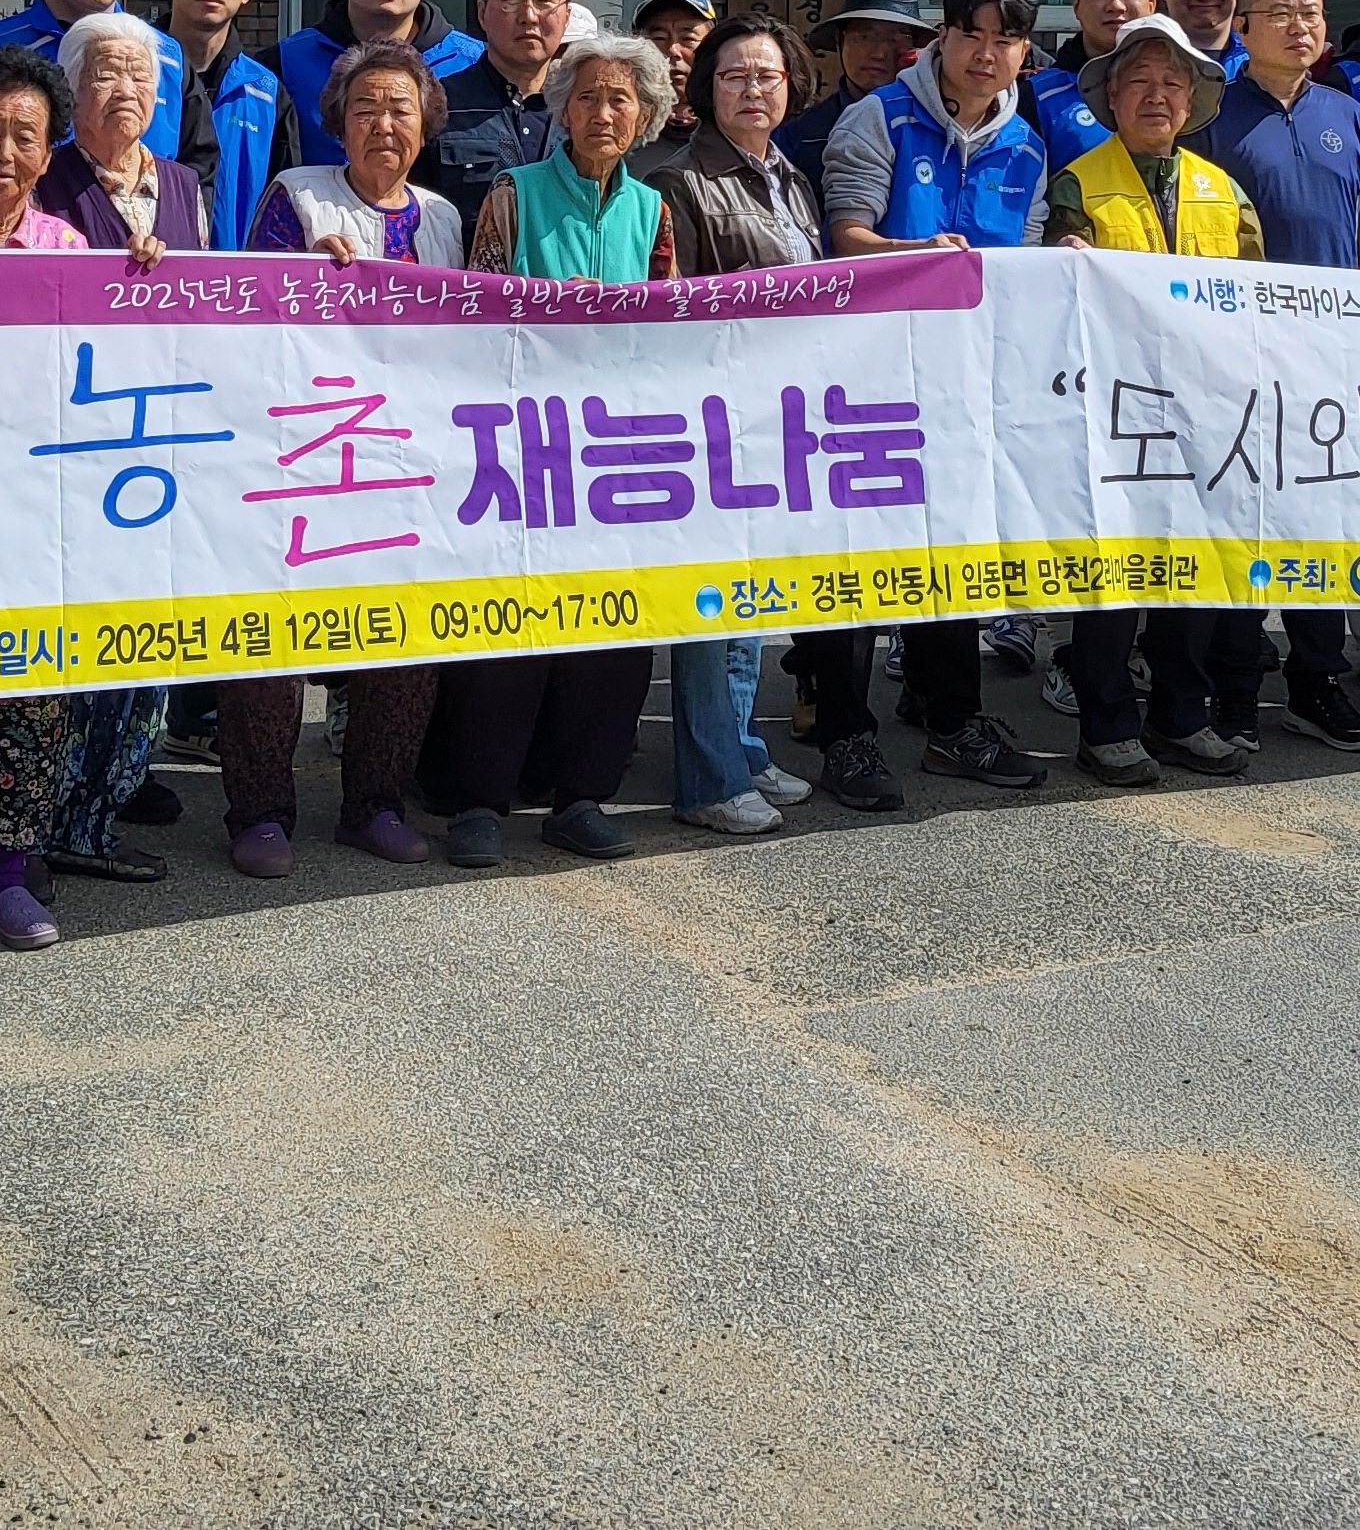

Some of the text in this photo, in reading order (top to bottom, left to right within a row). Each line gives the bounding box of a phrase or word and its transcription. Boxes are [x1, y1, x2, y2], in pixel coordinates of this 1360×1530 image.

[104, 268, 857, 320] 2025년도 농촌재능나눔 일반단체 활동지원사업
[1193, 277, 1246, 313] 시행:
[730, 553, 1199, 619] 장소: 경북 안동시 임동면 망천2리마을회관
[1275, 557, 1337, 594] 주최:
[96, 618, 209, 668] 2025년
[220, 611, 273, 658] 4월
[286, 600, 409, 652] 12일(토)
[431, 589, 640, 641] 09:00~17:00
